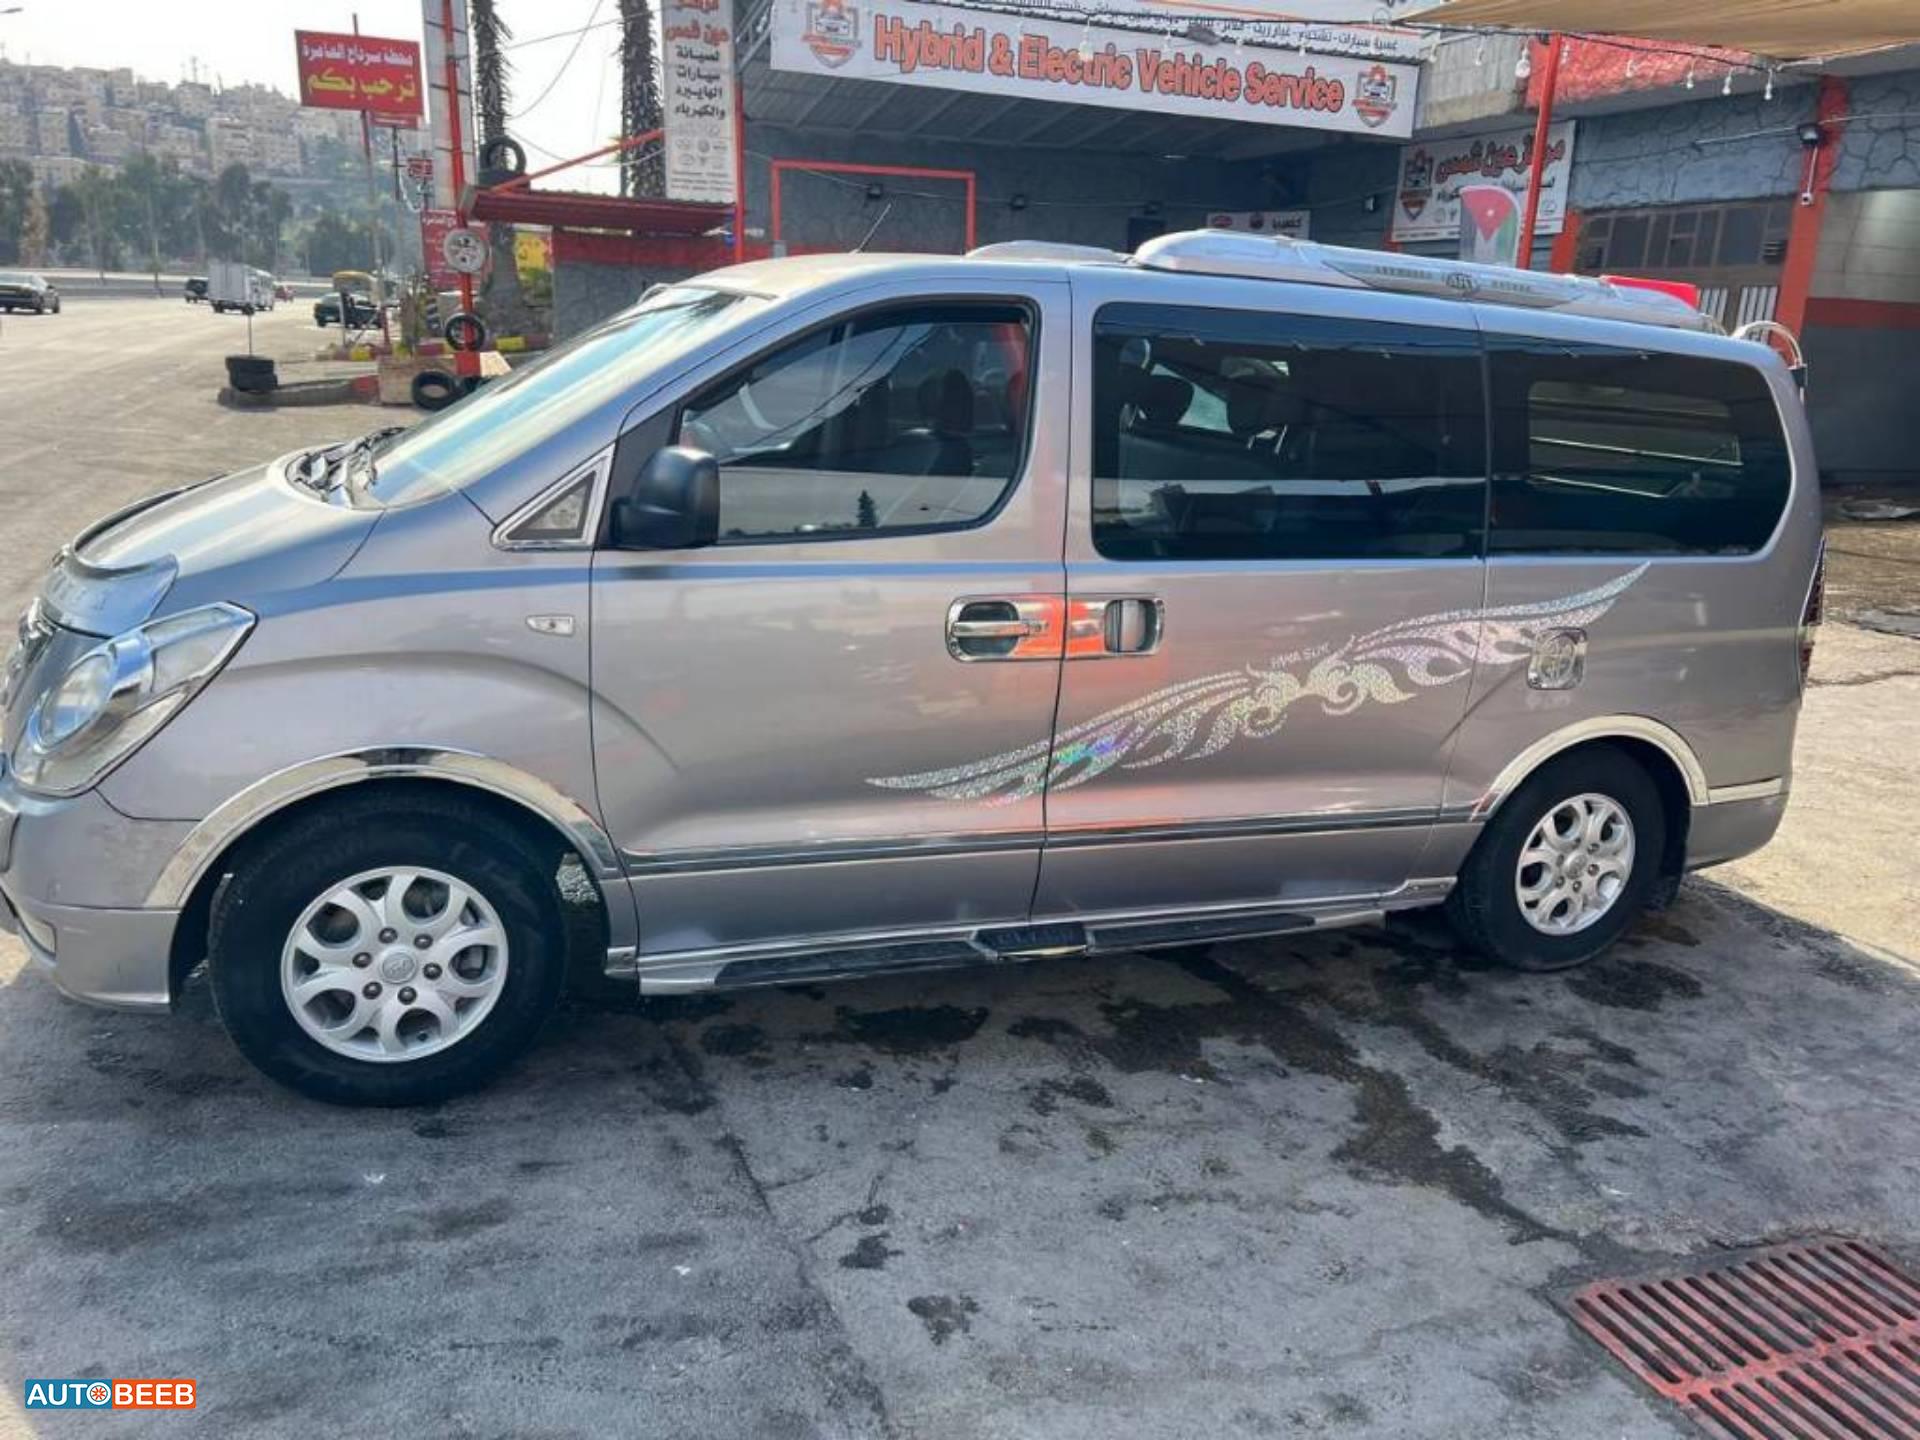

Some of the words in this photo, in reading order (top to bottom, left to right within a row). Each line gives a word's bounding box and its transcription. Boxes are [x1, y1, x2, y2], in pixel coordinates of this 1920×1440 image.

[676, 64, 720, 83] سيارات
[874, 14, 985, 73] Hybrid
[989, 32, 1015, 77] &
[1136, 48, 1242, 102] Vehicle
[1244, 60, 1345, 113] Service
[307, 68, 356, 100] بكم
[360, 73, 416, 103] ترحب
